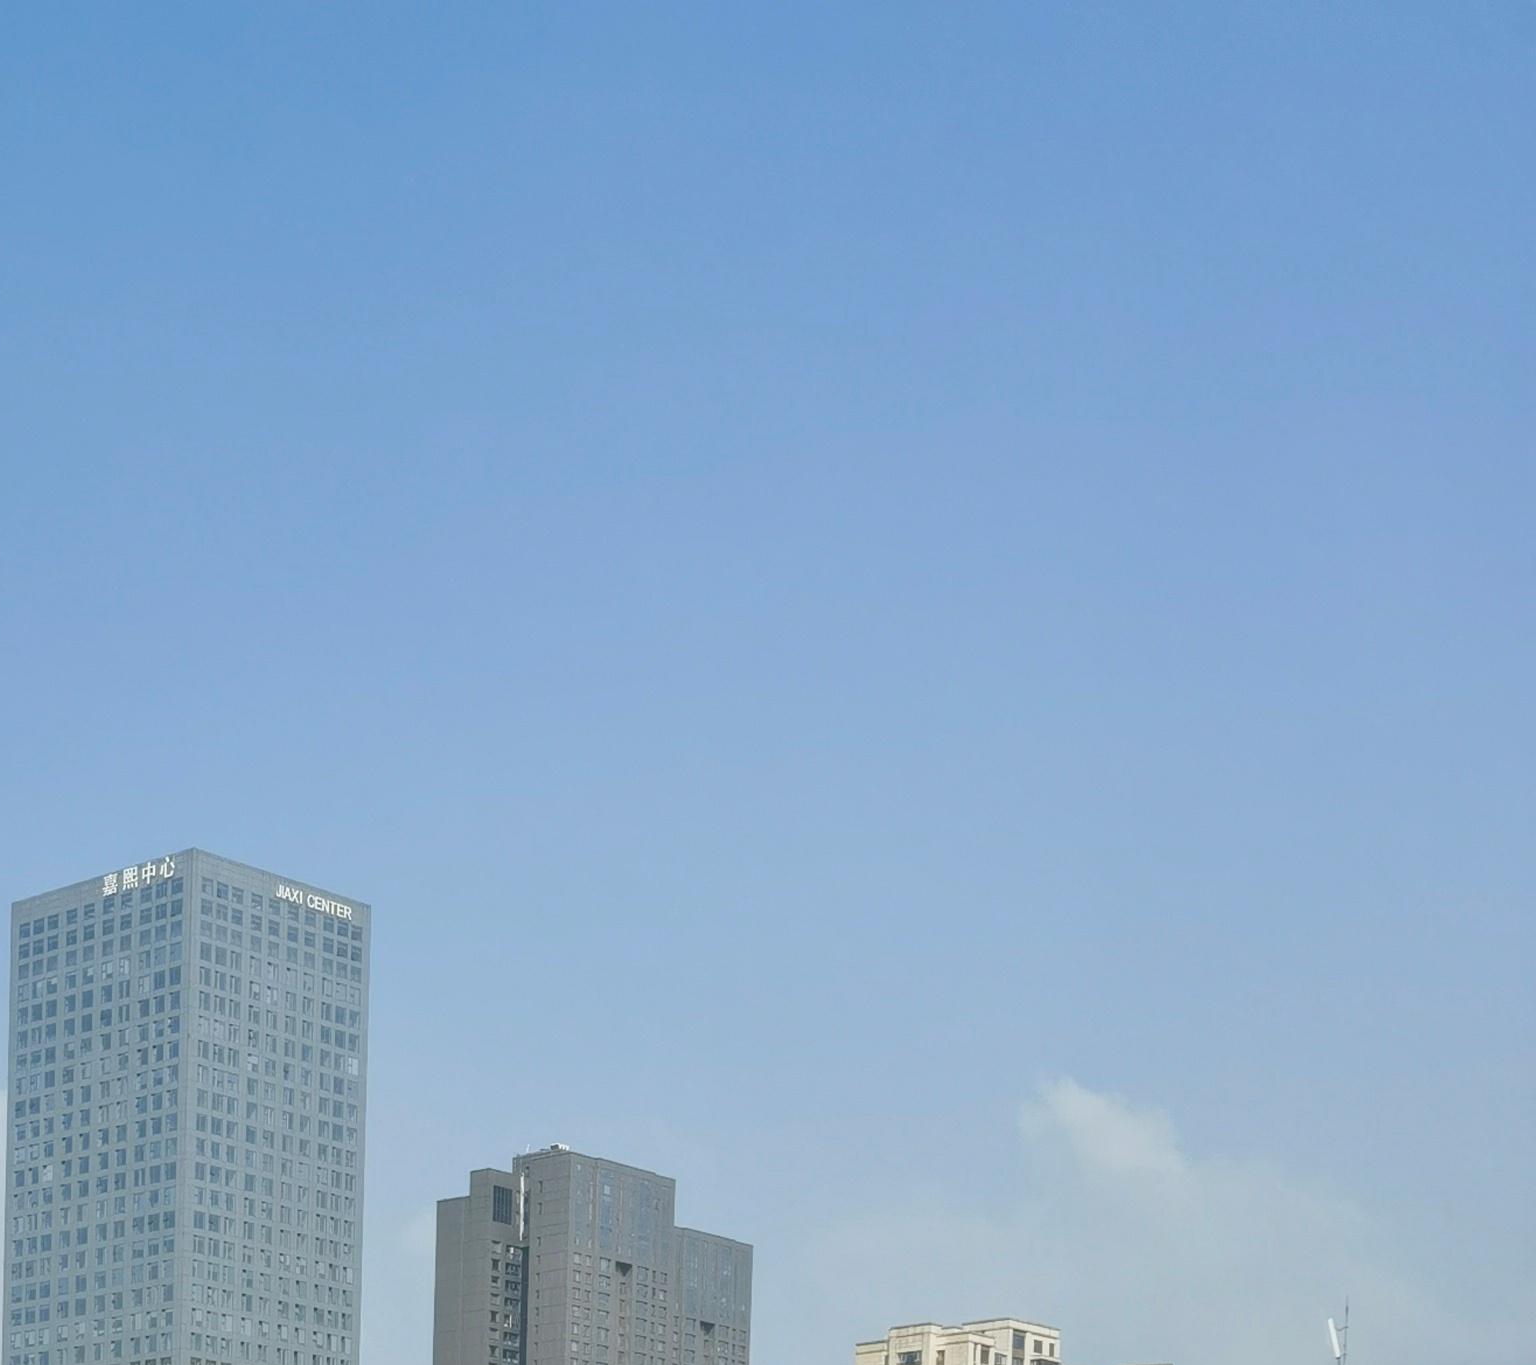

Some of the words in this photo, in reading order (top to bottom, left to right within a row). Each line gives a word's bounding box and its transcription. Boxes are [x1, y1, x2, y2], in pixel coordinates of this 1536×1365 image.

[102, 856, 175, 896] 嘉熙中心
[275, 884, 303, 904] JIAXI
[307, 894, 352, 920] CENTER
